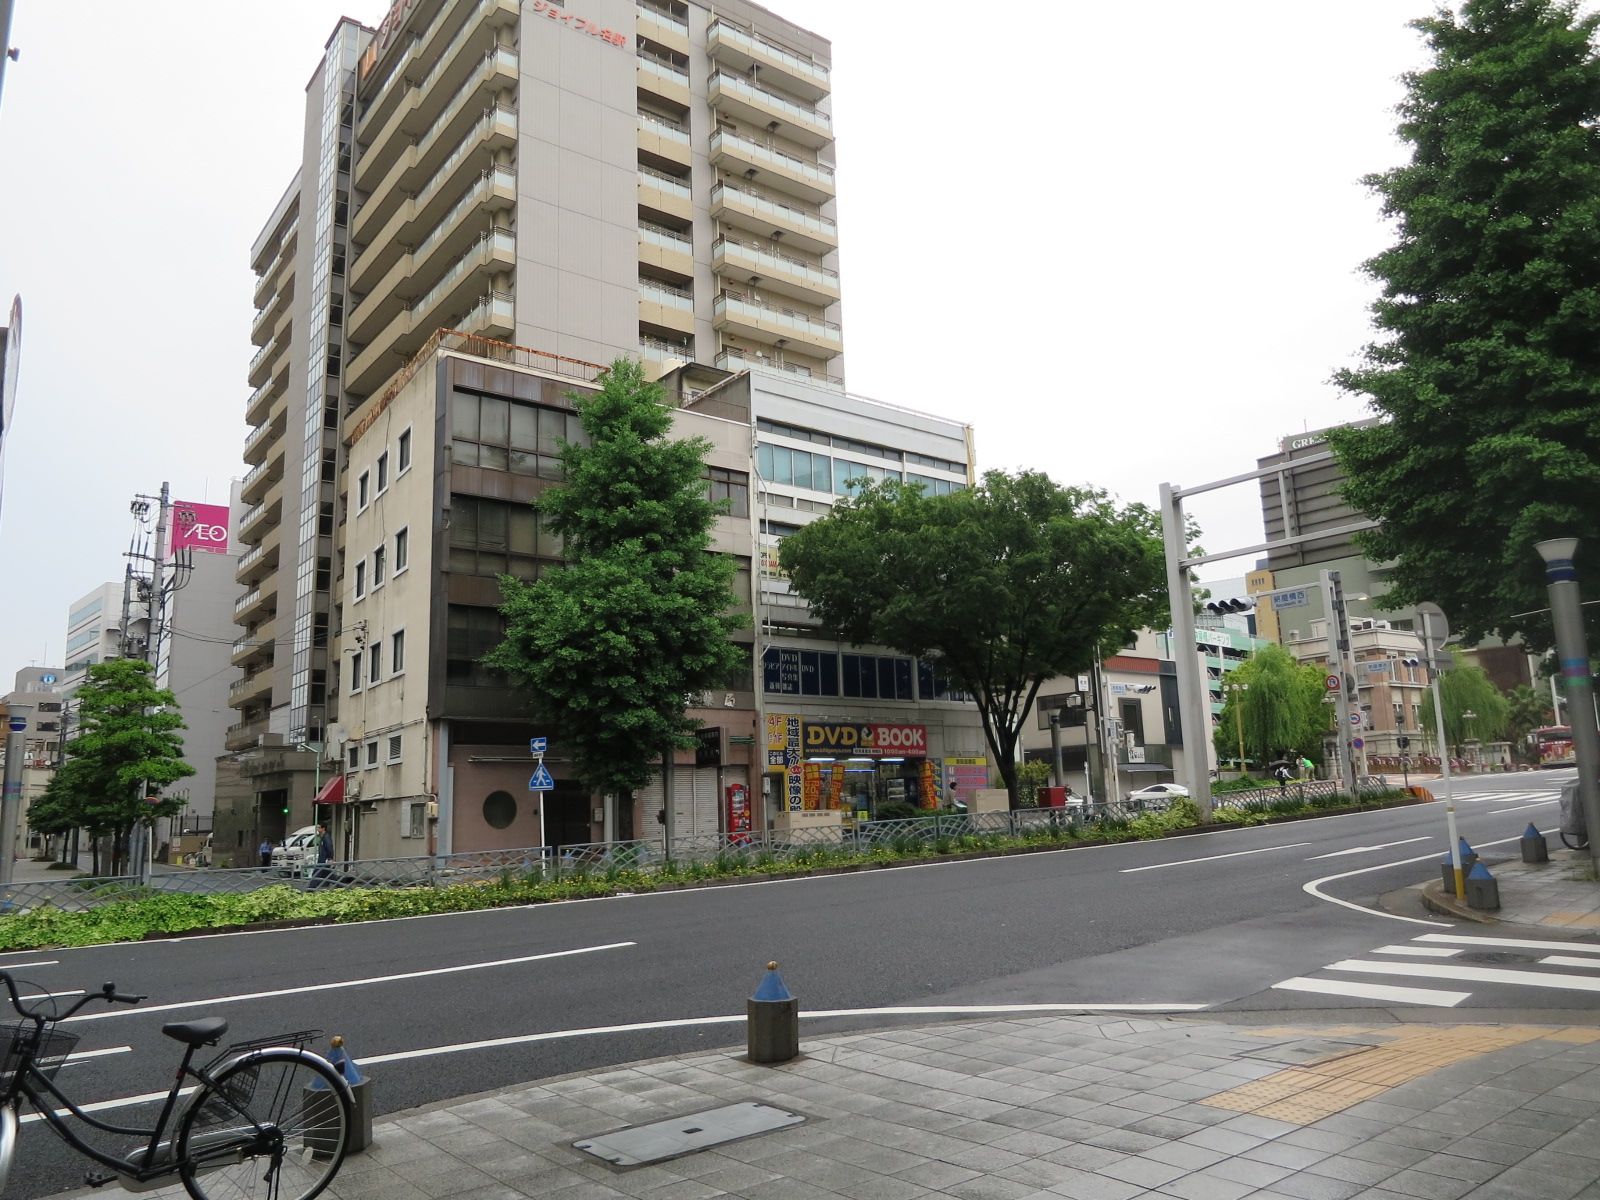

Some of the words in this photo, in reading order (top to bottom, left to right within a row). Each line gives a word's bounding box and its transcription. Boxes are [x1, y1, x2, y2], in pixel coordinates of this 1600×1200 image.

[806, 725, 858, 746] DVD
[877, 727, 925, 747] BOOK
[769, 756, 784, 765] 全部
